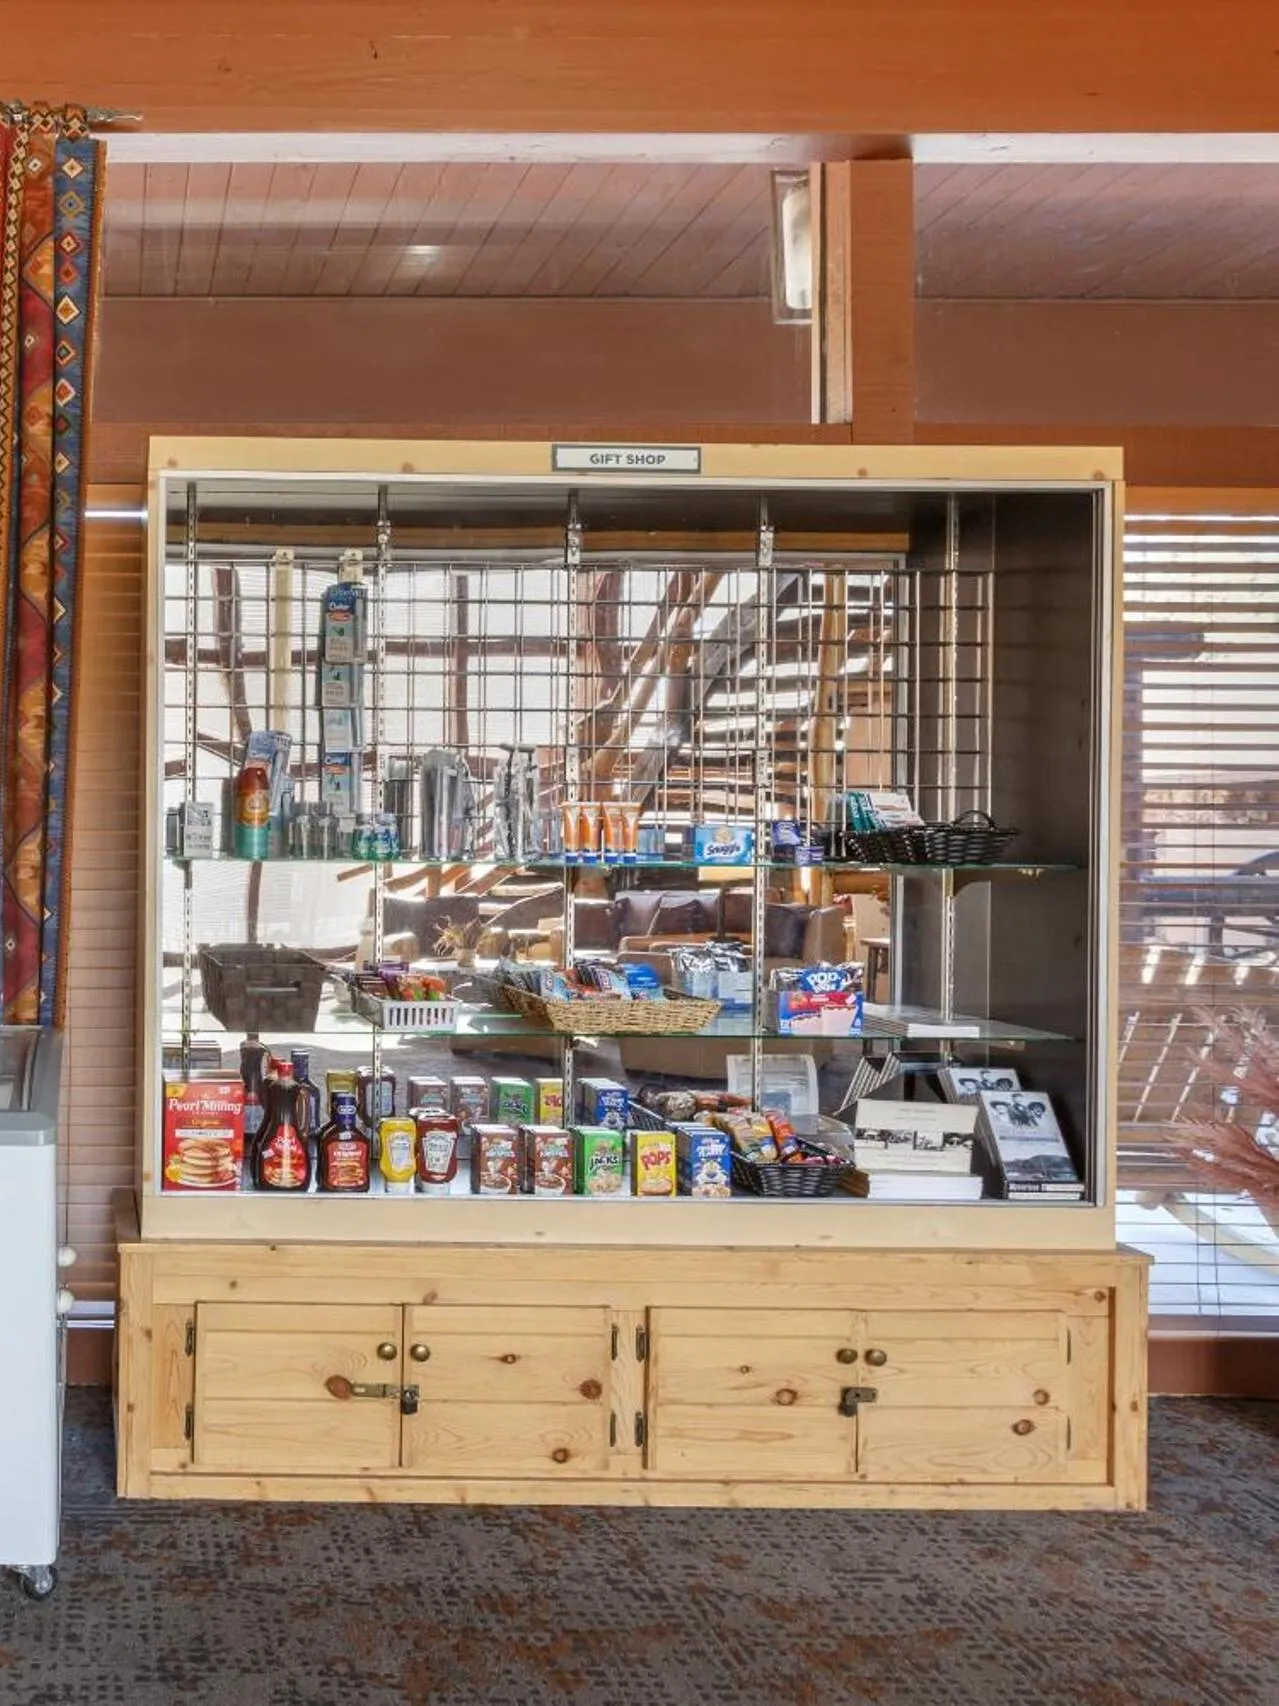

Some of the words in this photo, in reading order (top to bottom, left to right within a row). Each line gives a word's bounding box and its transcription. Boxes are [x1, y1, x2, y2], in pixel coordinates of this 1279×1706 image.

[589, 453, 622, 465] GIFT
[626, 453, 666, 465] SHOP
[641, 1151, 671, 1171] POPS
